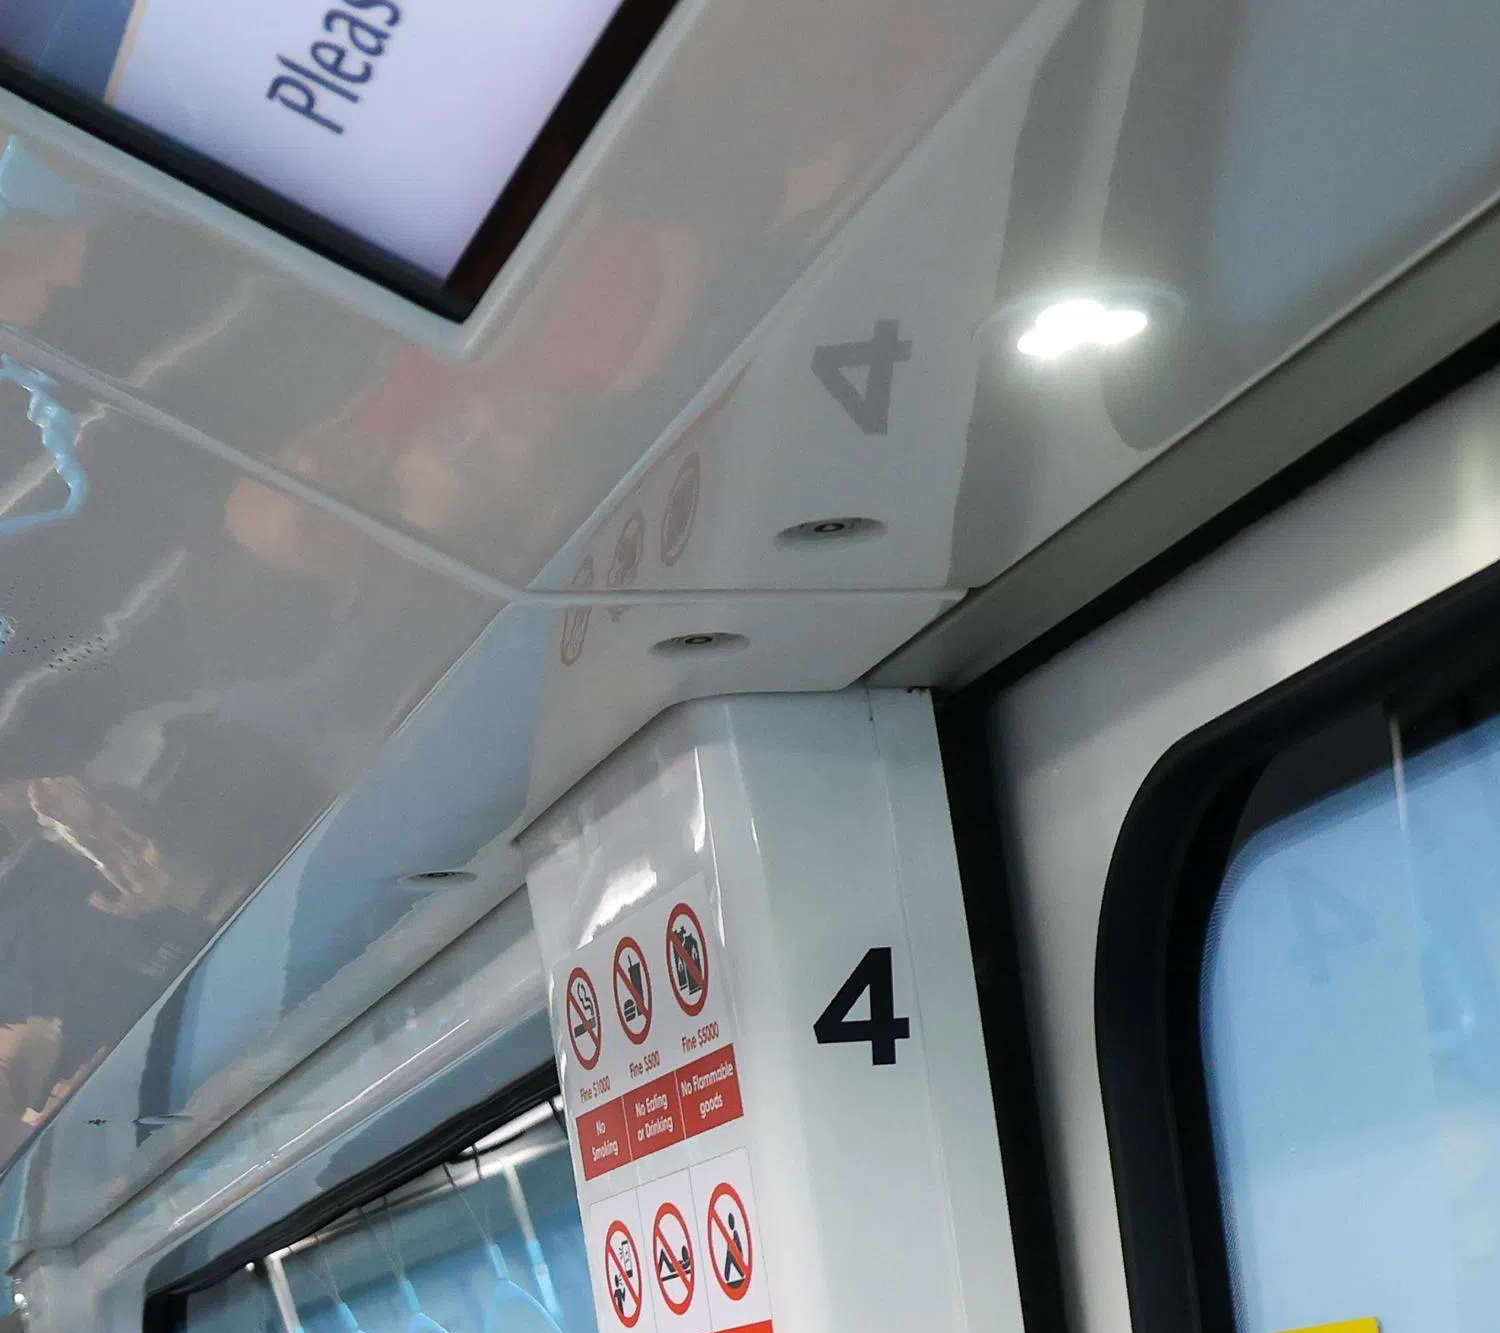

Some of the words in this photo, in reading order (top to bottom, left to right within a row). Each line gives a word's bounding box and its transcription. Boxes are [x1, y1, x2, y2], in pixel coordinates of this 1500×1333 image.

[813, 946, 911, 1066] 4
[681, 1036, 697, 1053] Fine
[697, 1021, 719, 1048] $5000
[629, 1062, 643, 1079] Fine
[643, 1050, 661, 1073] $500
[681, 1080, 693, 1097] No
[692, 1060, 734, 1093] Flammable
[635, 1102, 646, 1118] No
[646, 1093, 668, 1113] Eating
[700, 1091, 724, 1119] goods
[595, 1120, 606, 1136] No
[637, 1128, 646, 1142] or
[645, 1115, 674, 1138] Drinking
[591, 1140, 618, 1162] Smoking
